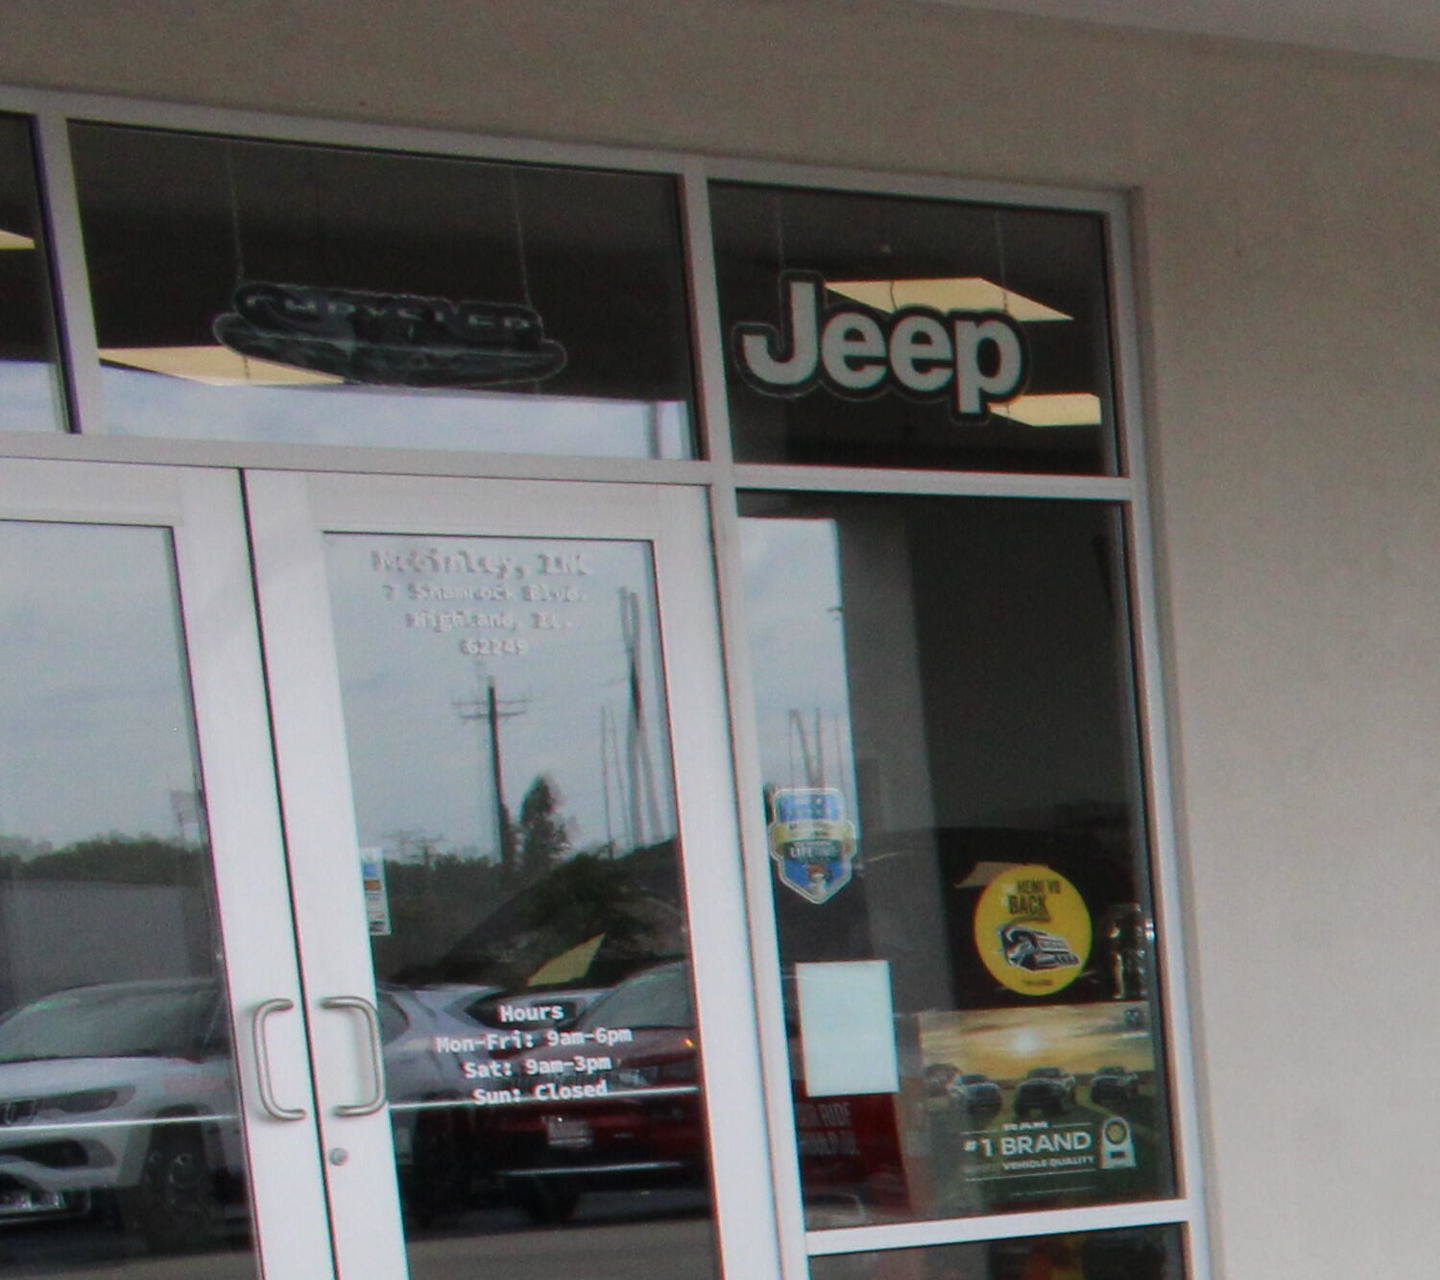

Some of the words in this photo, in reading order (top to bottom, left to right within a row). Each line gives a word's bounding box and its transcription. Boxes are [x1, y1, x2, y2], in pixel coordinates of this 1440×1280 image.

[742, 280, 1023, 414] Jeep
[500, 1005, 565, 1023] Hours
[435, 1030, 534, 1053] Mon-Fri:
[546, 1027, 634, 1047] 9am-6pm
[462, 1060, 513, 1079] Sat:
[524, 1055, 612, 1075] 9am-3pm
[472, 1087, 522, 1105] Sun:
[533, 1080, 608, 1101] Closed
[1000, 1131, 1092, 1156] BRAND
[1002, 1157, 1048, 1171] VEHICLE
[1049, 1154, 1095, 1167] QUALITY
